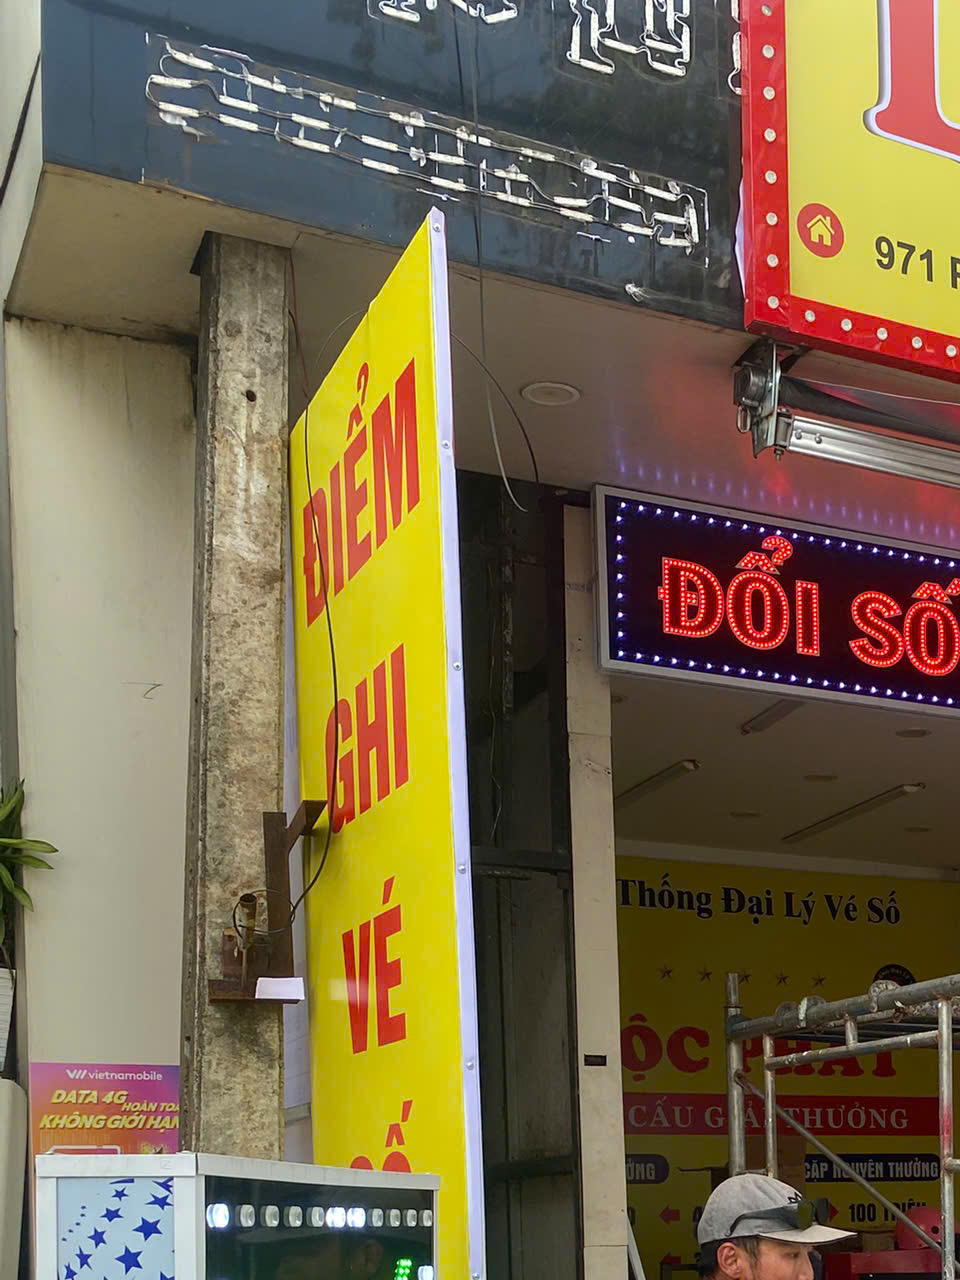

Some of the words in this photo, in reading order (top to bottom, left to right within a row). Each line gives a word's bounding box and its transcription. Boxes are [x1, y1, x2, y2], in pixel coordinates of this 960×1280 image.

[874, 235, 935, 284] 971
[302, 360, 421, 627] ĐIỂM
[657, 535, 821, 657] ĐỔI
[325, 643, 409, 835] GHI
[615, 872, 712, 919] Thống
[720, 886, 774, 925] Đại
[783, 890, 816, 926] Lý
[823, 893, 858, 923] Vé
[866, 889, 901, 925] Số
[342, 878, 408, 1055] VÉ
[88, 1069, 163, 1081] vietnamobile
[51, 1089, 98, 1105] DATA
[102, 1090, 129, 1105] 4G
[627, 1096, 695, 1129] CẤU
[785, 1101, 909, 1129] THƯỞNG
[39, 1111, 107, 1130] KHÔNG
[107, 1111, 146, 1129] GIỚI
[887, 1157, 939, 1178] THƯỞNG
[849, 1203, 877, 1223] 100
